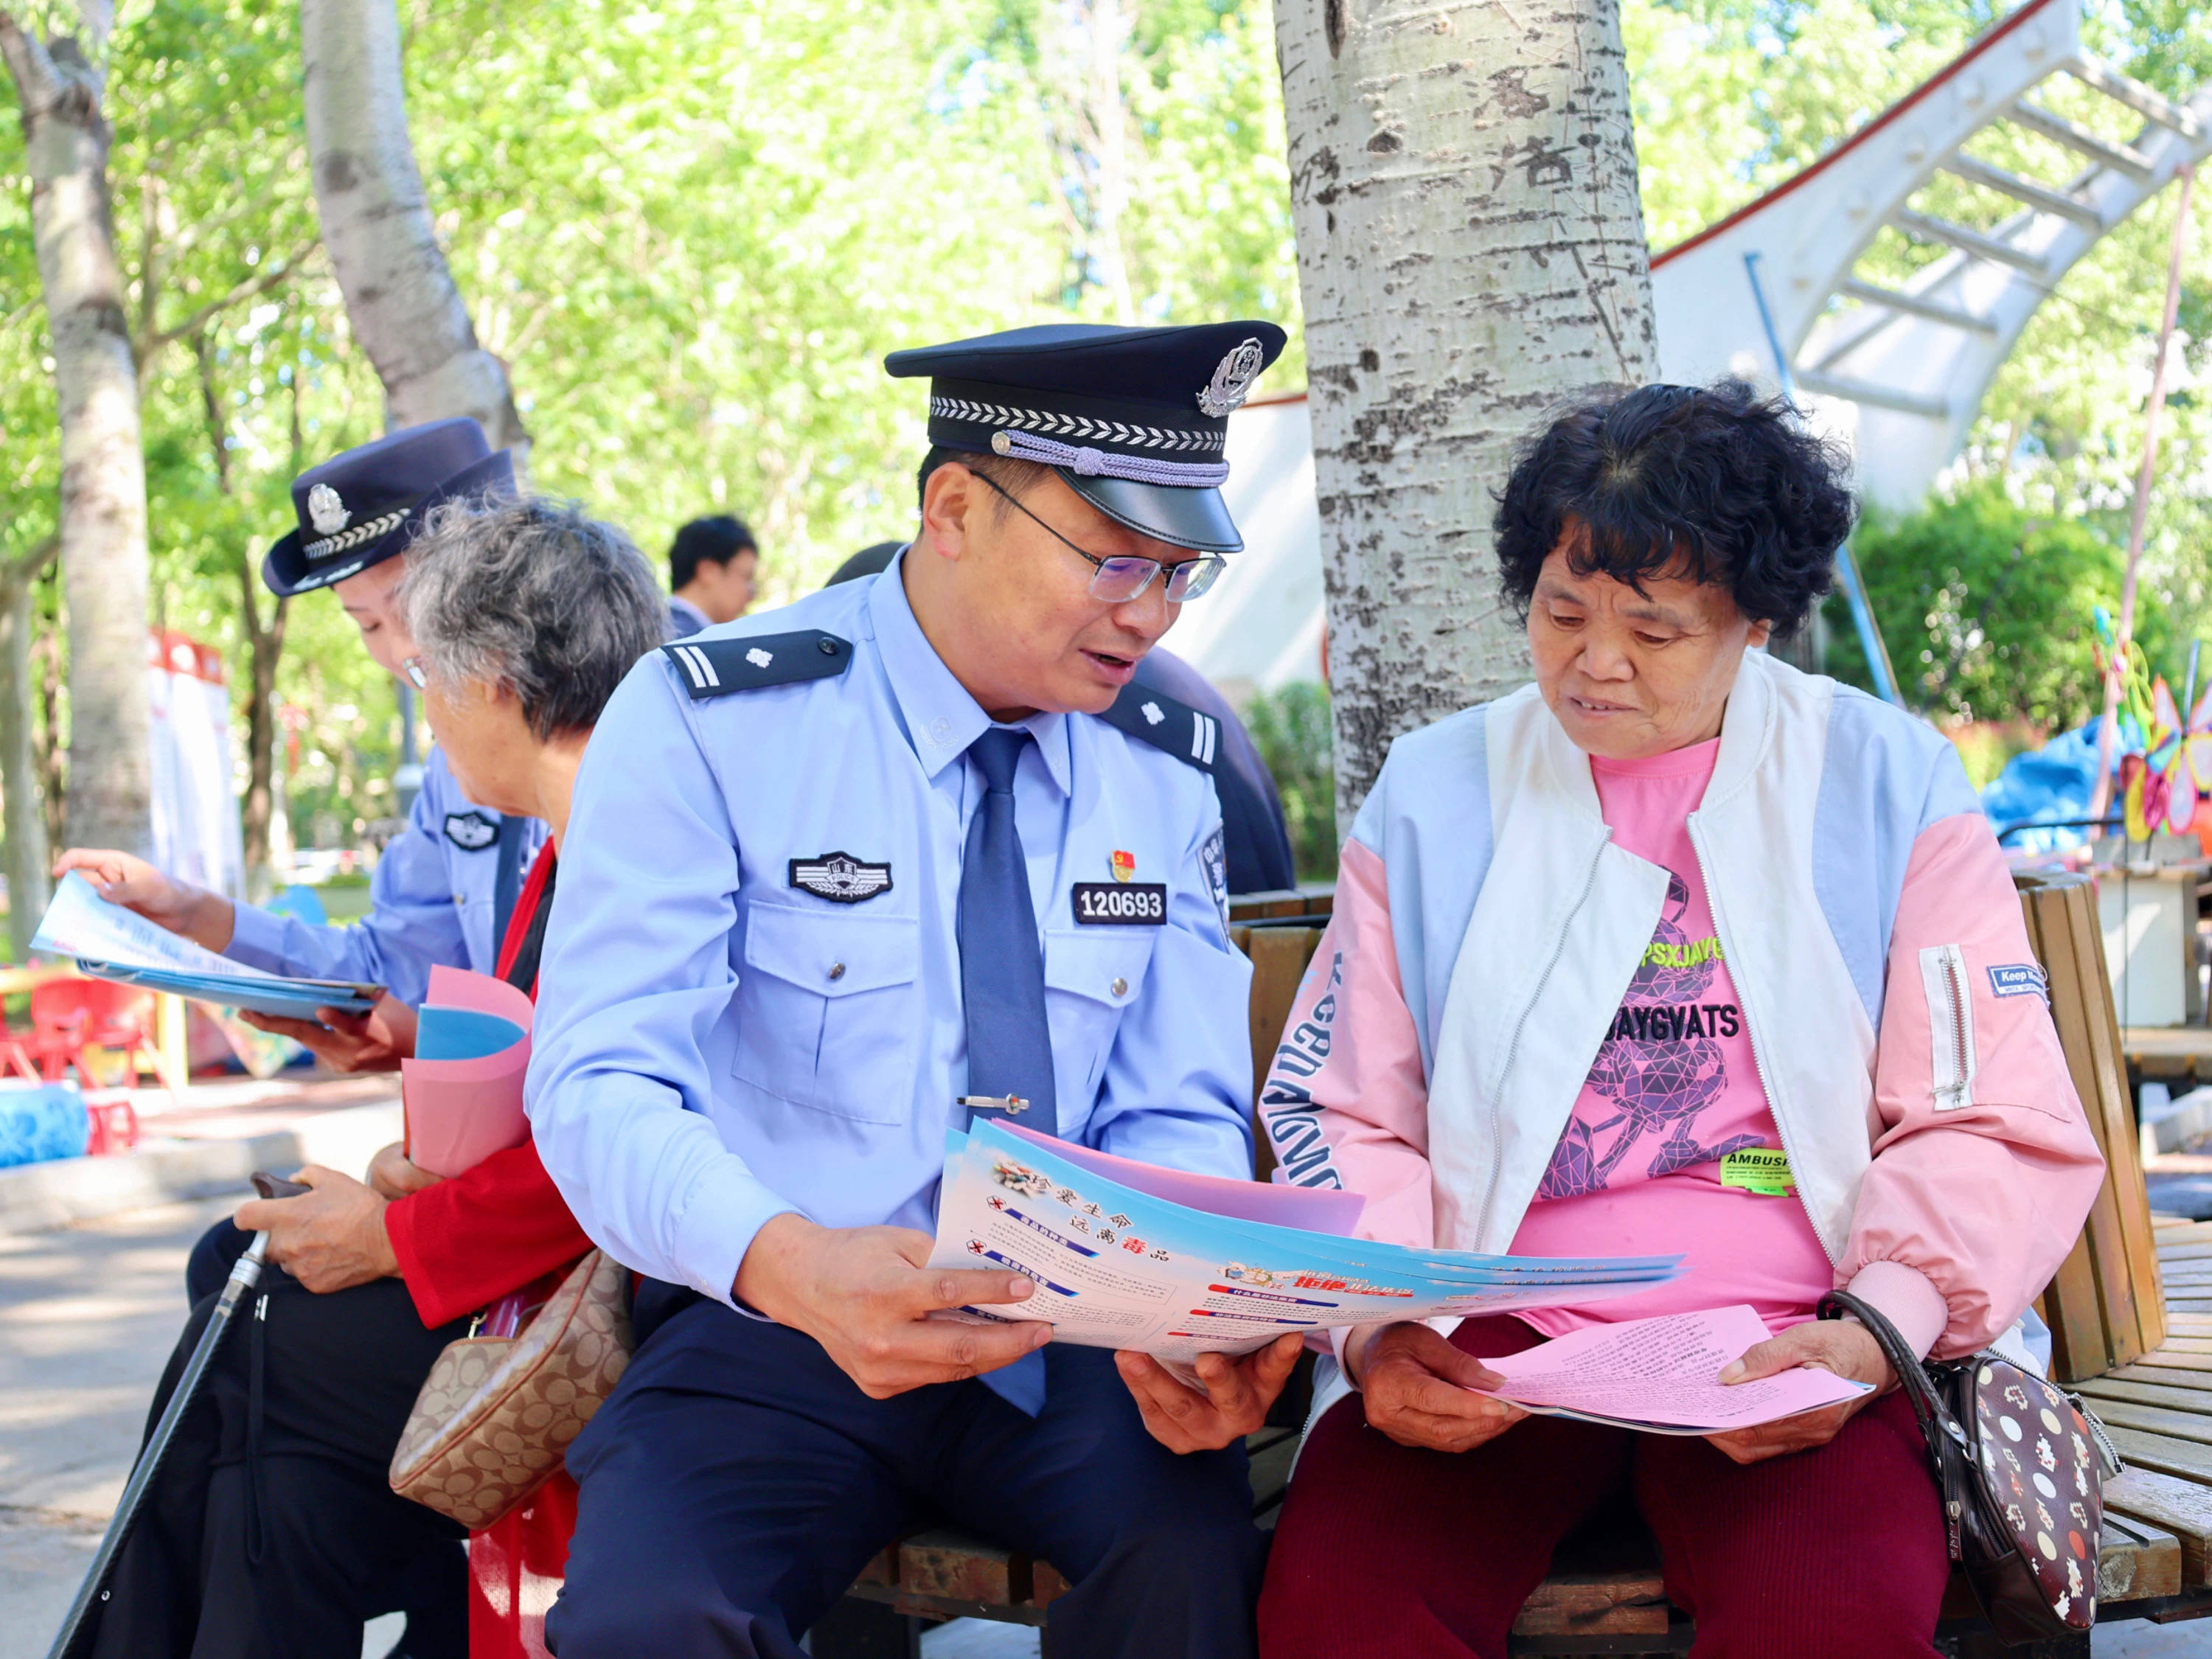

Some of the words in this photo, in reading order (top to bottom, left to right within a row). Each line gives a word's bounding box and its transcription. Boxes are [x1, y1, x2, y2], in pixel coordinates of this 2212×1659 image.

[832, 873, 855, 882] POLICE
[1081, 891, 1162, 917] 120693
[2001, 971, 2027, 982] Keep
[1031, 1174, 1133, 1229] 珍爱生命
[1069, 1215, 1169, 1262] 远离毒品
